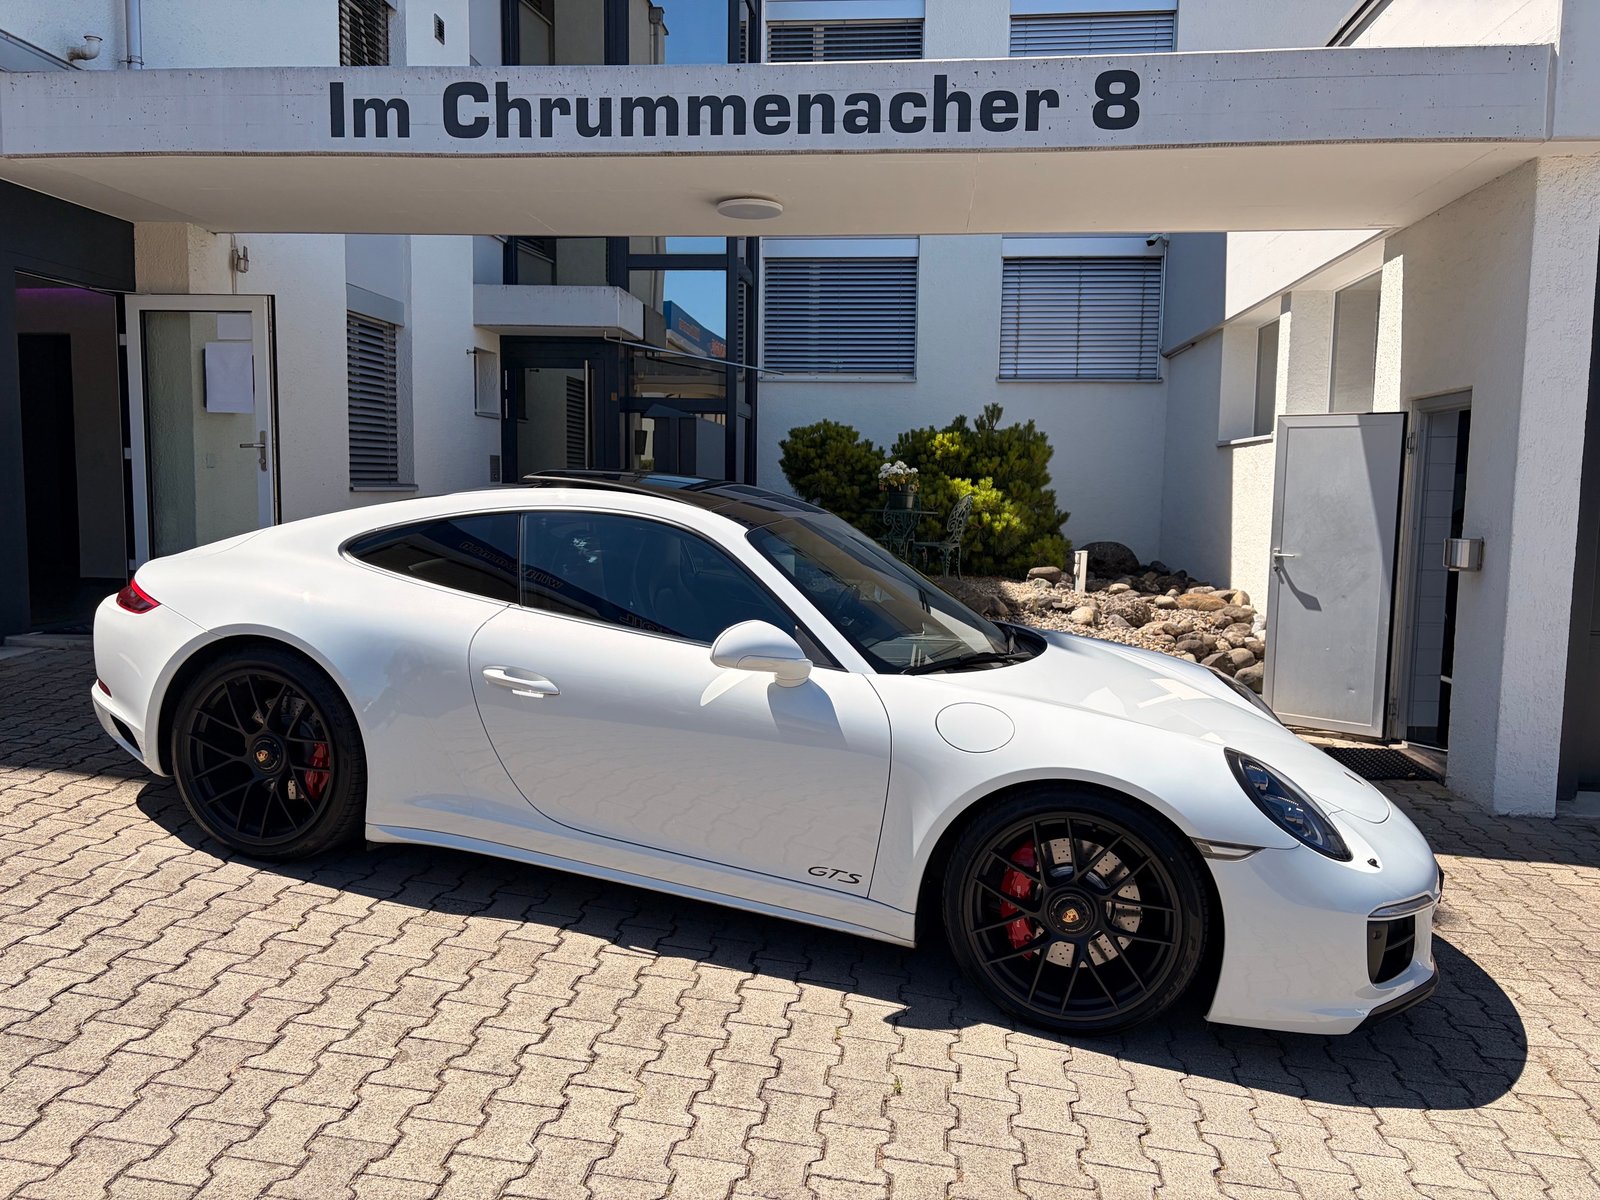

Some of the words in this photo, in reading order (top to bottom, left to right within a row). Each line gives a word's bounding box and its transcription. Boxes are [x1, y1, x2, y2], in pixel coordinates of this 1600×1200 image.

[329, 81, 410, 138] Im
[442, 74, 1060, 139] Chrummenacher
[1092, 69, 1141, 131] 8
[807, 866, 863, 885] GTS
